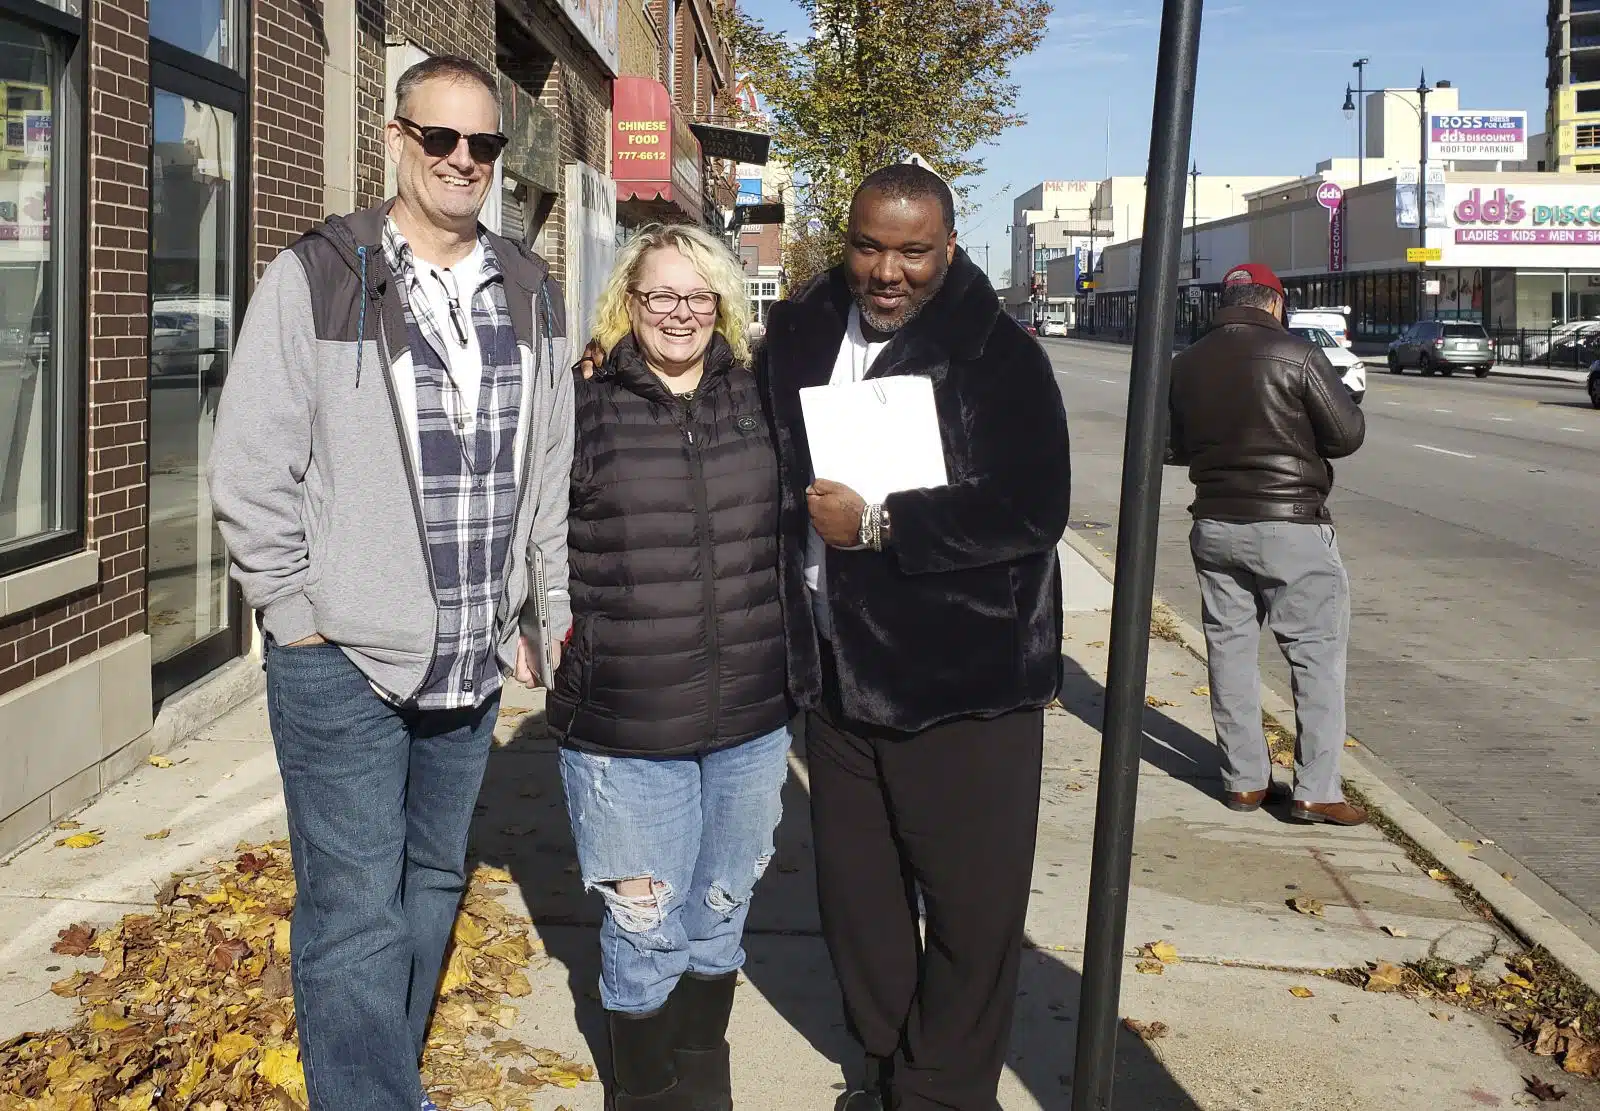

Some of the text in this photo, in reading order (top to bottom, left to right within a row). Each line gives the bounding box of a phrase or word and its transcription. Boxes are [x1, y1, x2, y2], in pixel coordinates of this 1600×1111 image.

[617, 121, 667, 131] CHINESE
[1439, 116, 1483, 128] ROSS
[628, 134, 659, 145] FOOD
[1440, 129, 1516, 142] dd's DISCOUNTS
[1440, 145, 1514, 153] ROOFTOP PARKING
[617, 151, 666, 160] 777-6612
[736, 168, 760, 176] AILS
[1453, 187, 1600, 226] dd's DISCO
[1462, 230, 1499, 241] LADIES
[1511, 231, 1536, 241] KIDS
[1549, 231, 1574, 241] MEN
